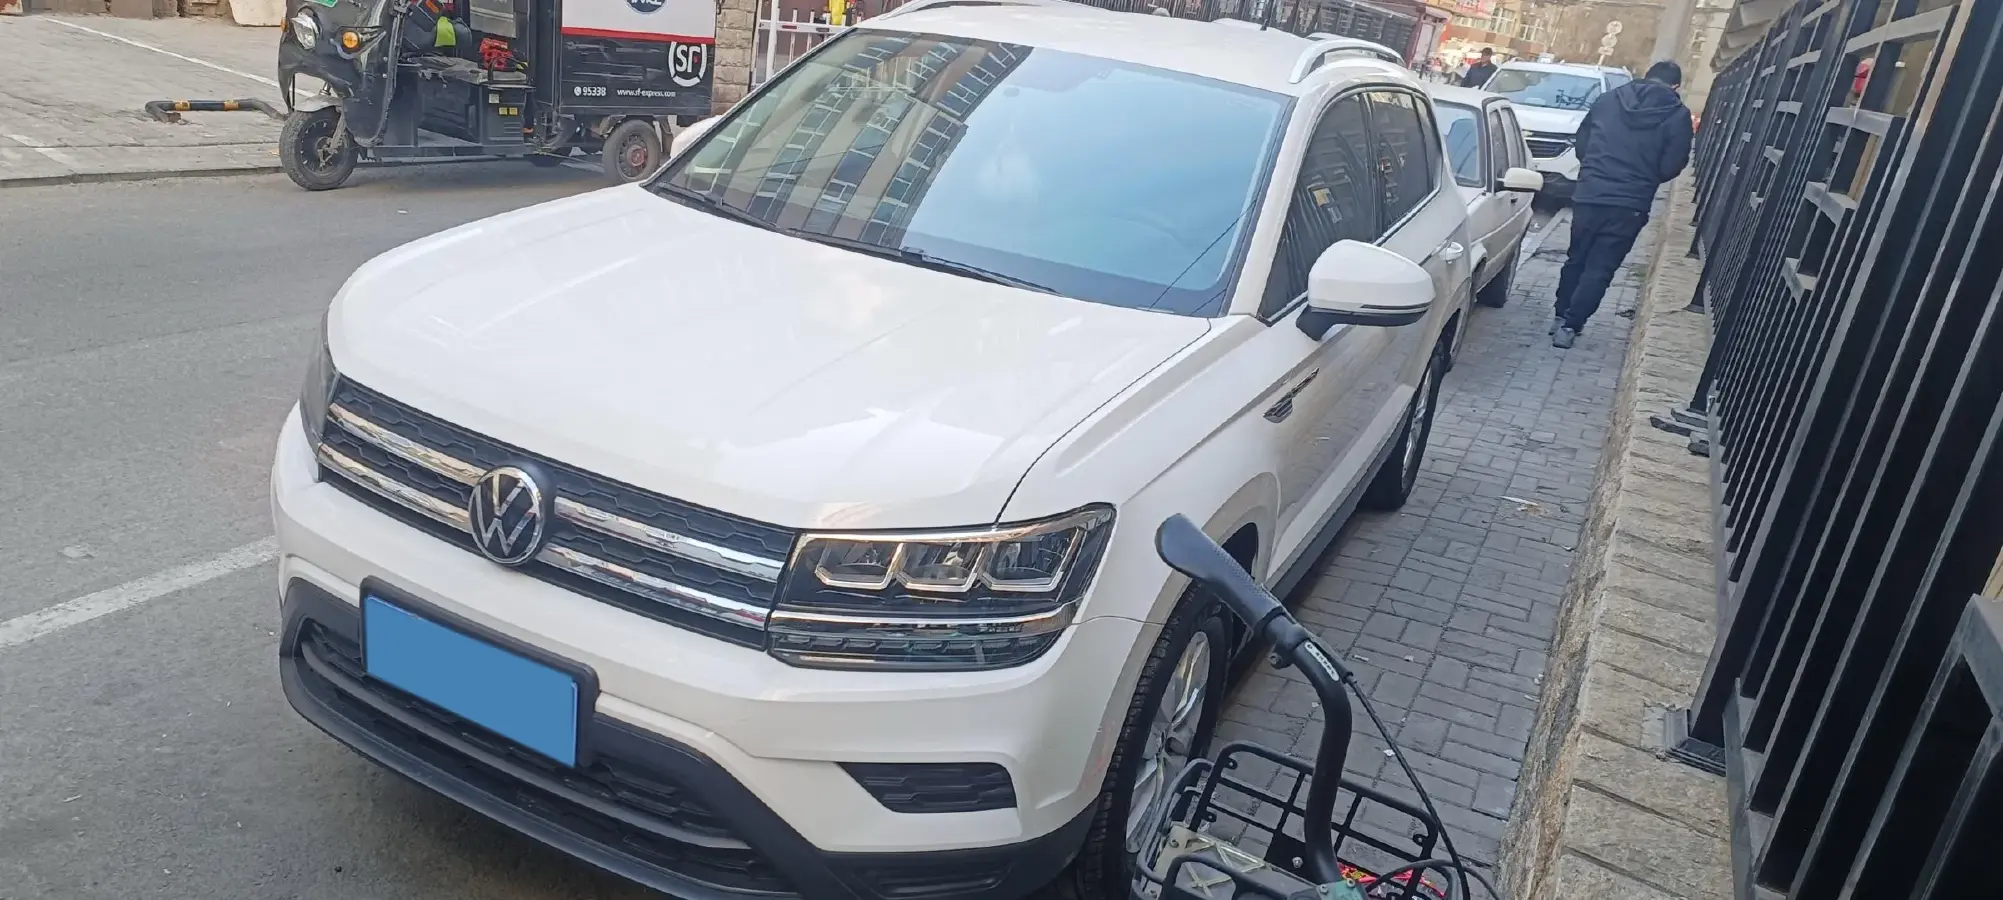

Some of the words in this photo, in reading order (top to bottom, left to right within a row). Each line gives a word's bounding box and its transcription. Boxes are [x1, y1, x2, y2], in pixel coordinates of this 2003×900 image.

[676, 44, 701, 73] SF
[582, 86, 607, 97] 95338
[616, 87, 676, 98] www.sf-express.com
[474, 473, 539, 556] VW
